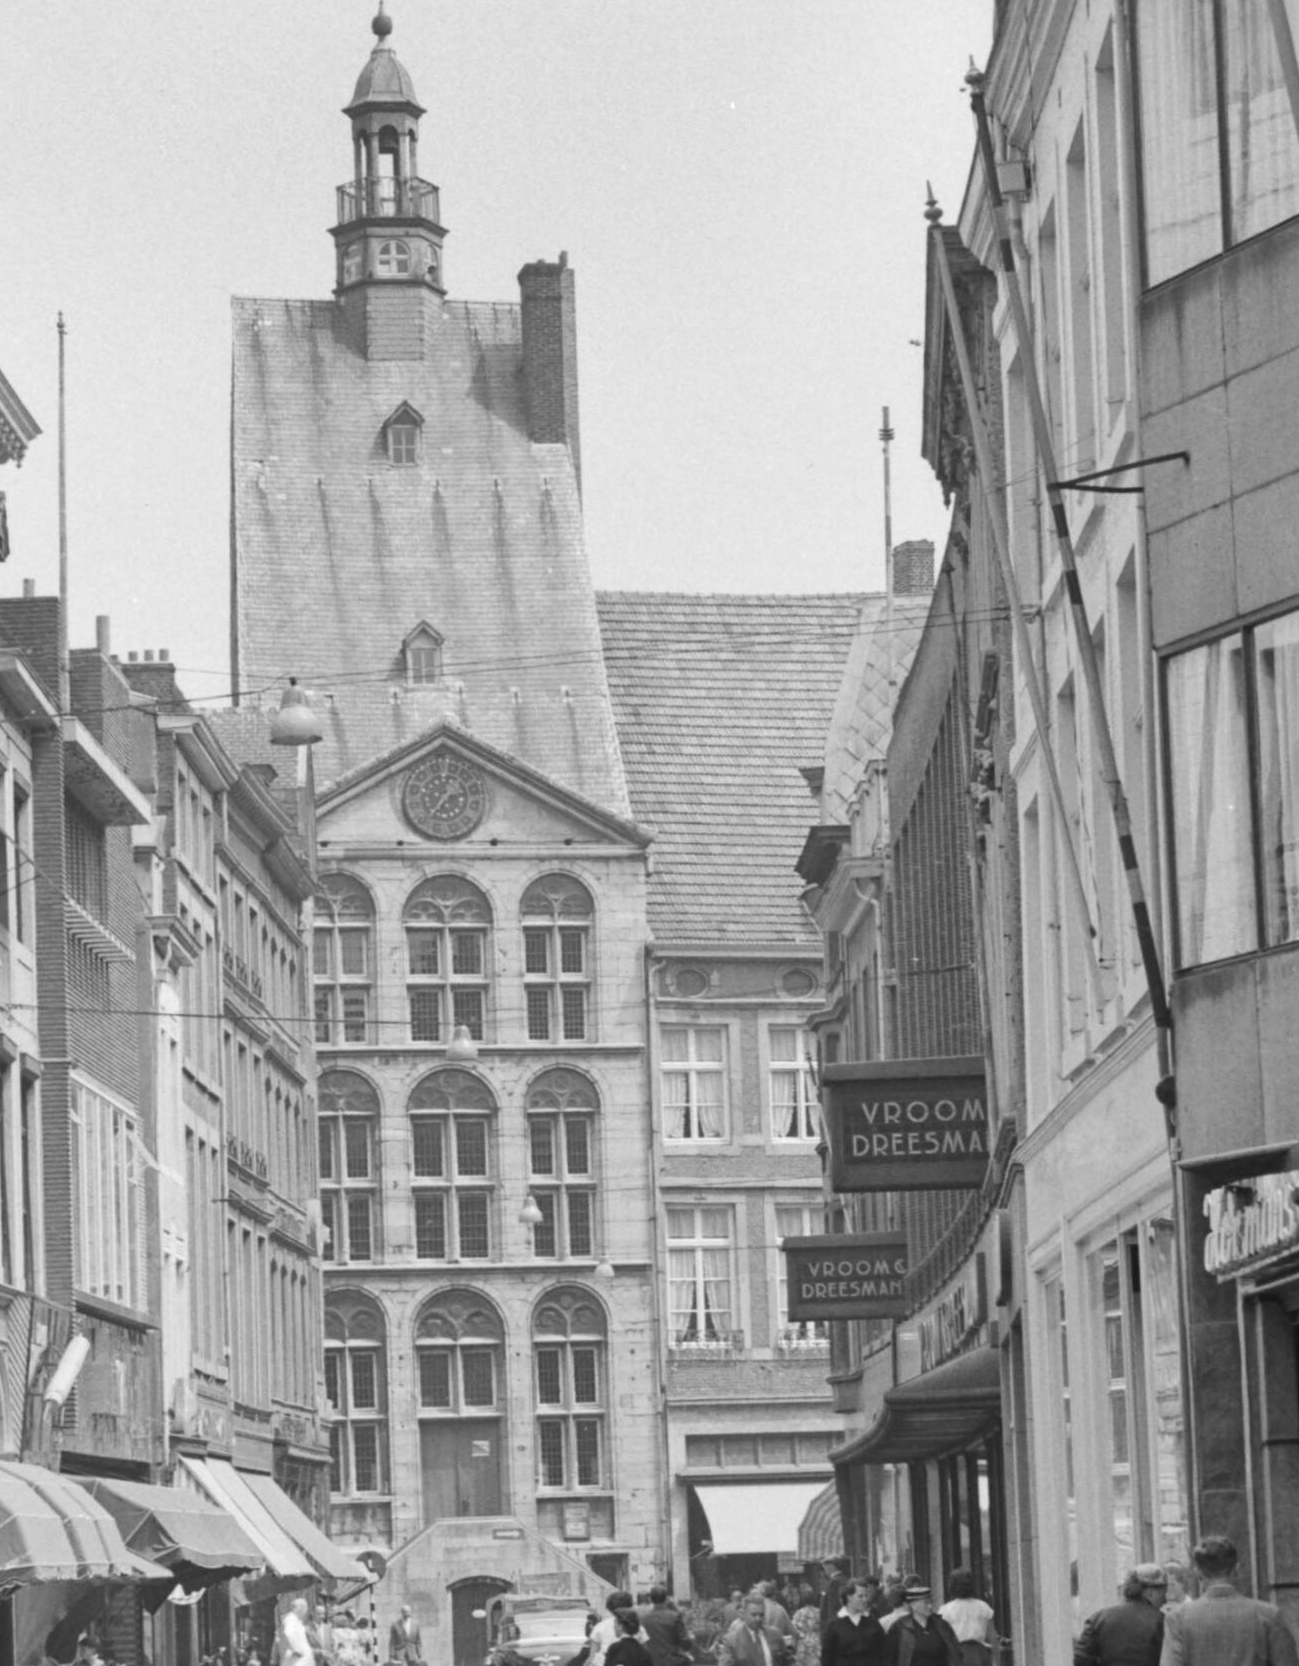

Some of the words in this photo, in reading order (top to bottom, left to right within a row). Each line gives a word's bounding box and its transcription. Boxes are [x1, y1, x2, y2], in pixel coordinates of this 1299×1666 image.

[860, 1098, 986, 1125] VROOM
[852, 1130, 989, 1158] DREESMA
[807, 1259, 890, 1278] VROOM
